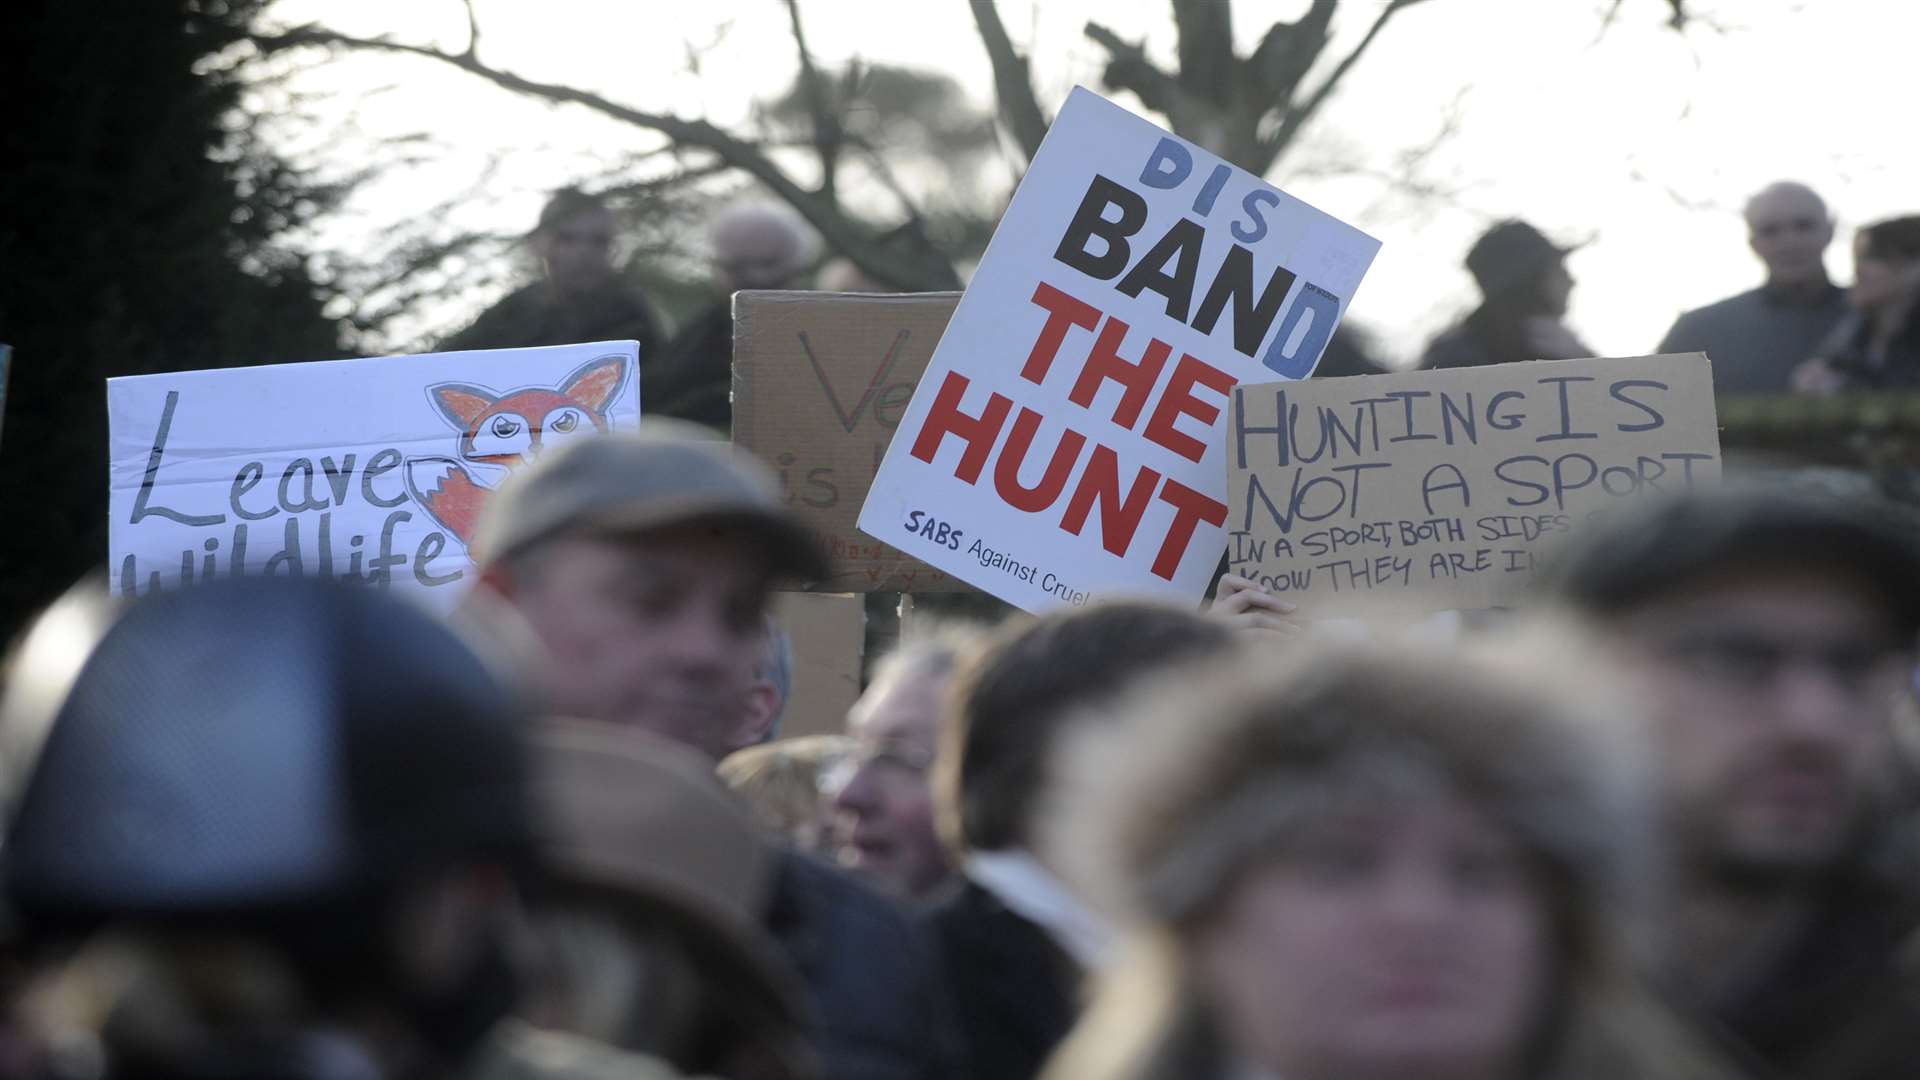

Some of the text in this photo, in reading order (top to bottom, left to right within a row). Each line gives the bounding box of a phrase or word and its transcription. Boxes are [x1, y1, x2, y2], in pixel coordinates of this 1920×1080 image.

[1139, 136, 1280, 244] DIS
[1020, 281, 1239, 464] THE
[130, 391, 411, 526] Leave
[1235, 377, 1668, 469] HUNTING IS
[910, 370, 1229, 582] HUNT
[1245, 453, 1712, 533] NOT A SPORT
[904, 511, 963, 550] SABS
[968, 539, 1037, 585] Against
[1229, 515, 1570, 564] IN A SPORT, BOTH SIDES
[1316, 556, 1412, 592] THEY
[1430, 549, 1492, 580] ARE
